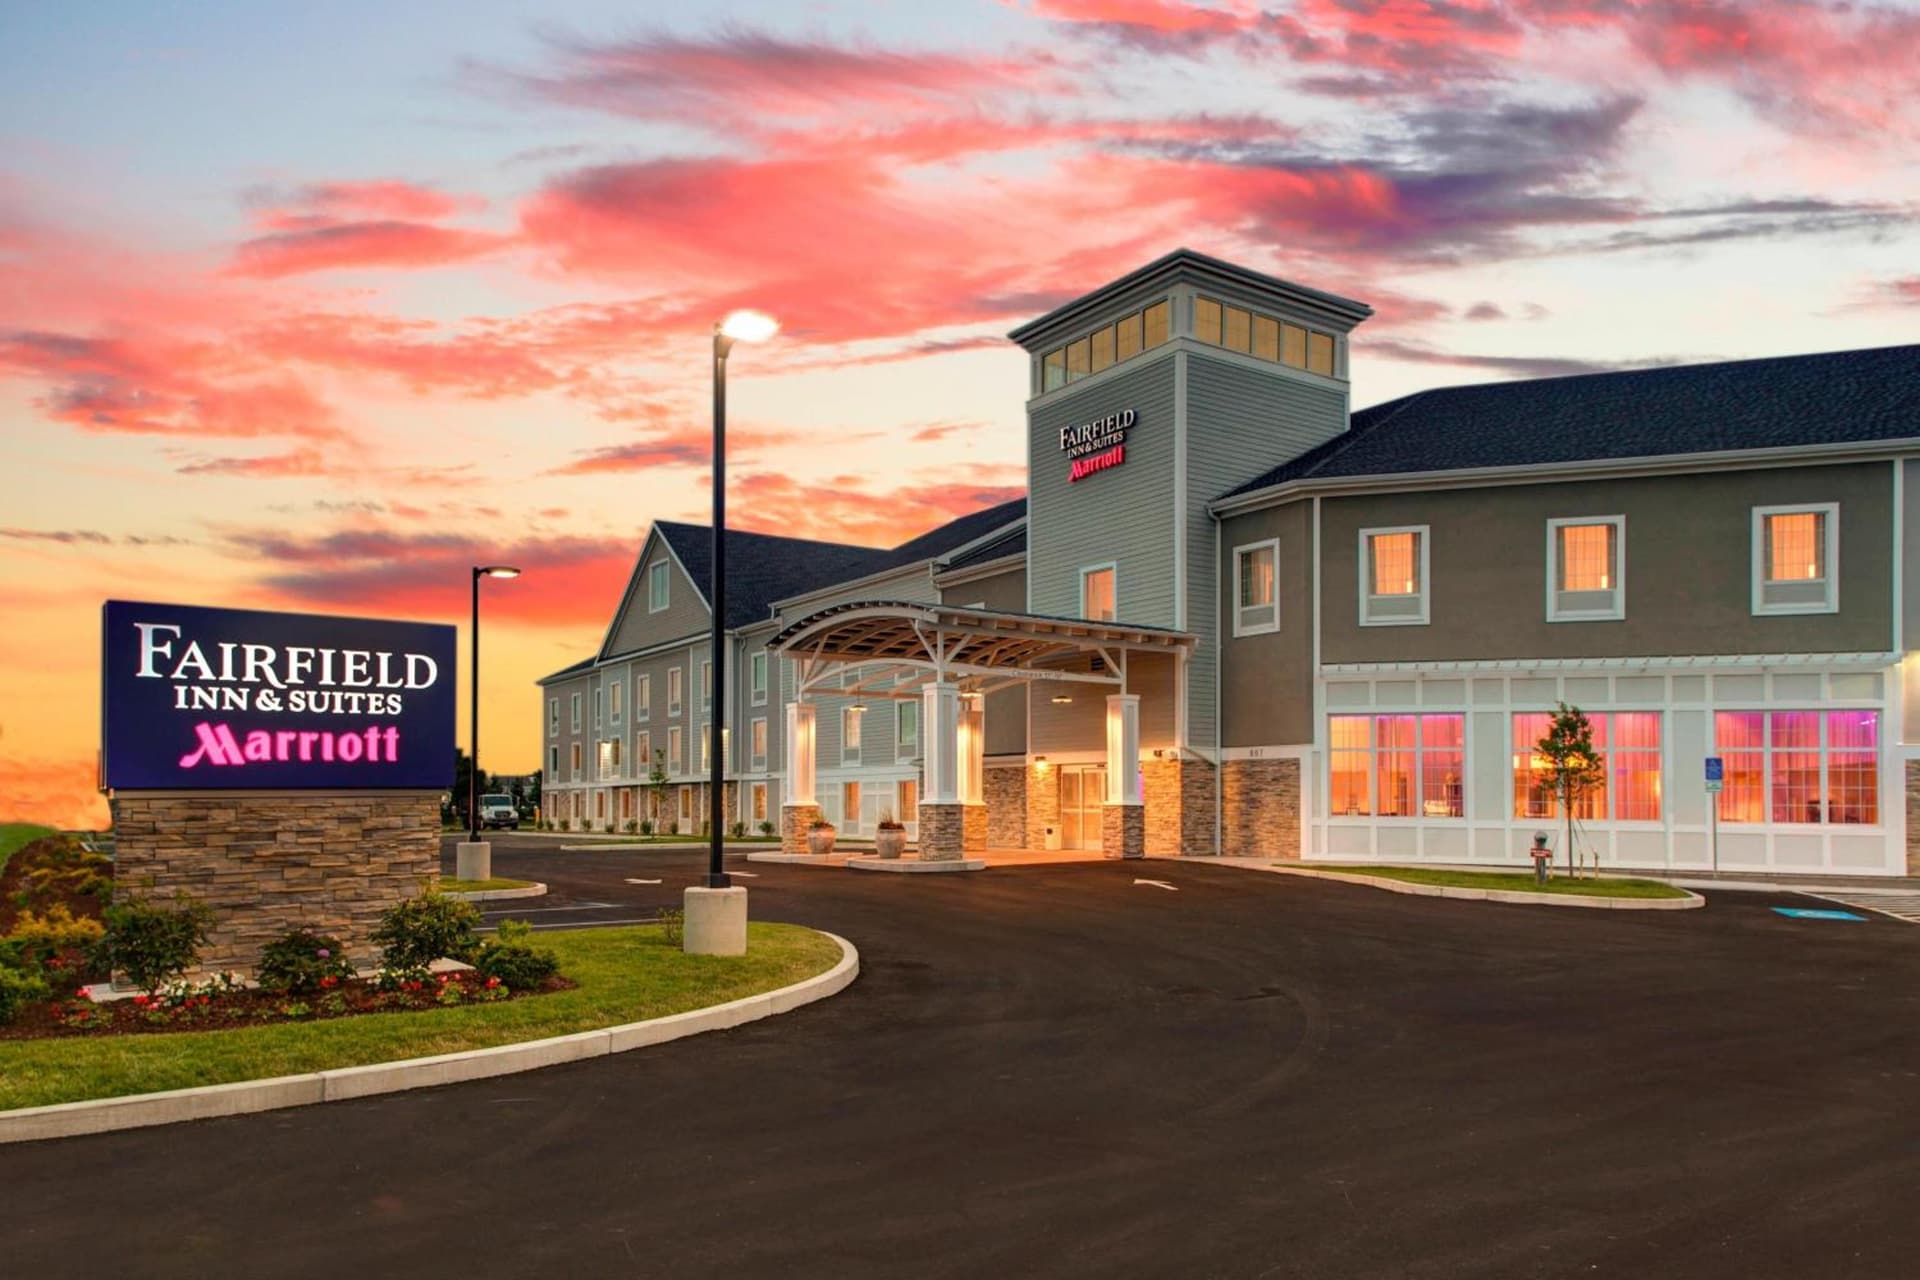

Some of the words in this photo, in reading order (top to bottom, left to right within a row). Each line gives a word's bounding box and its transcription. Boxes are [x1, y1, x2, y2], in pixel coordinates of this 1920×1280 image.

[1060, 409, 1134, 450] FAIRFIELD
[1067, 445, 1085, 459] INN
[1092, 431, 1124, 449] SUITES
[1067, 445, 1124, 483] Marriott
[133, 622, 438, 690] FAIRFIELD
[173, 685, 251, 711] INN
[288, 689, 403, 716] SUITES
[179, 722, 400, 768] Marriott
